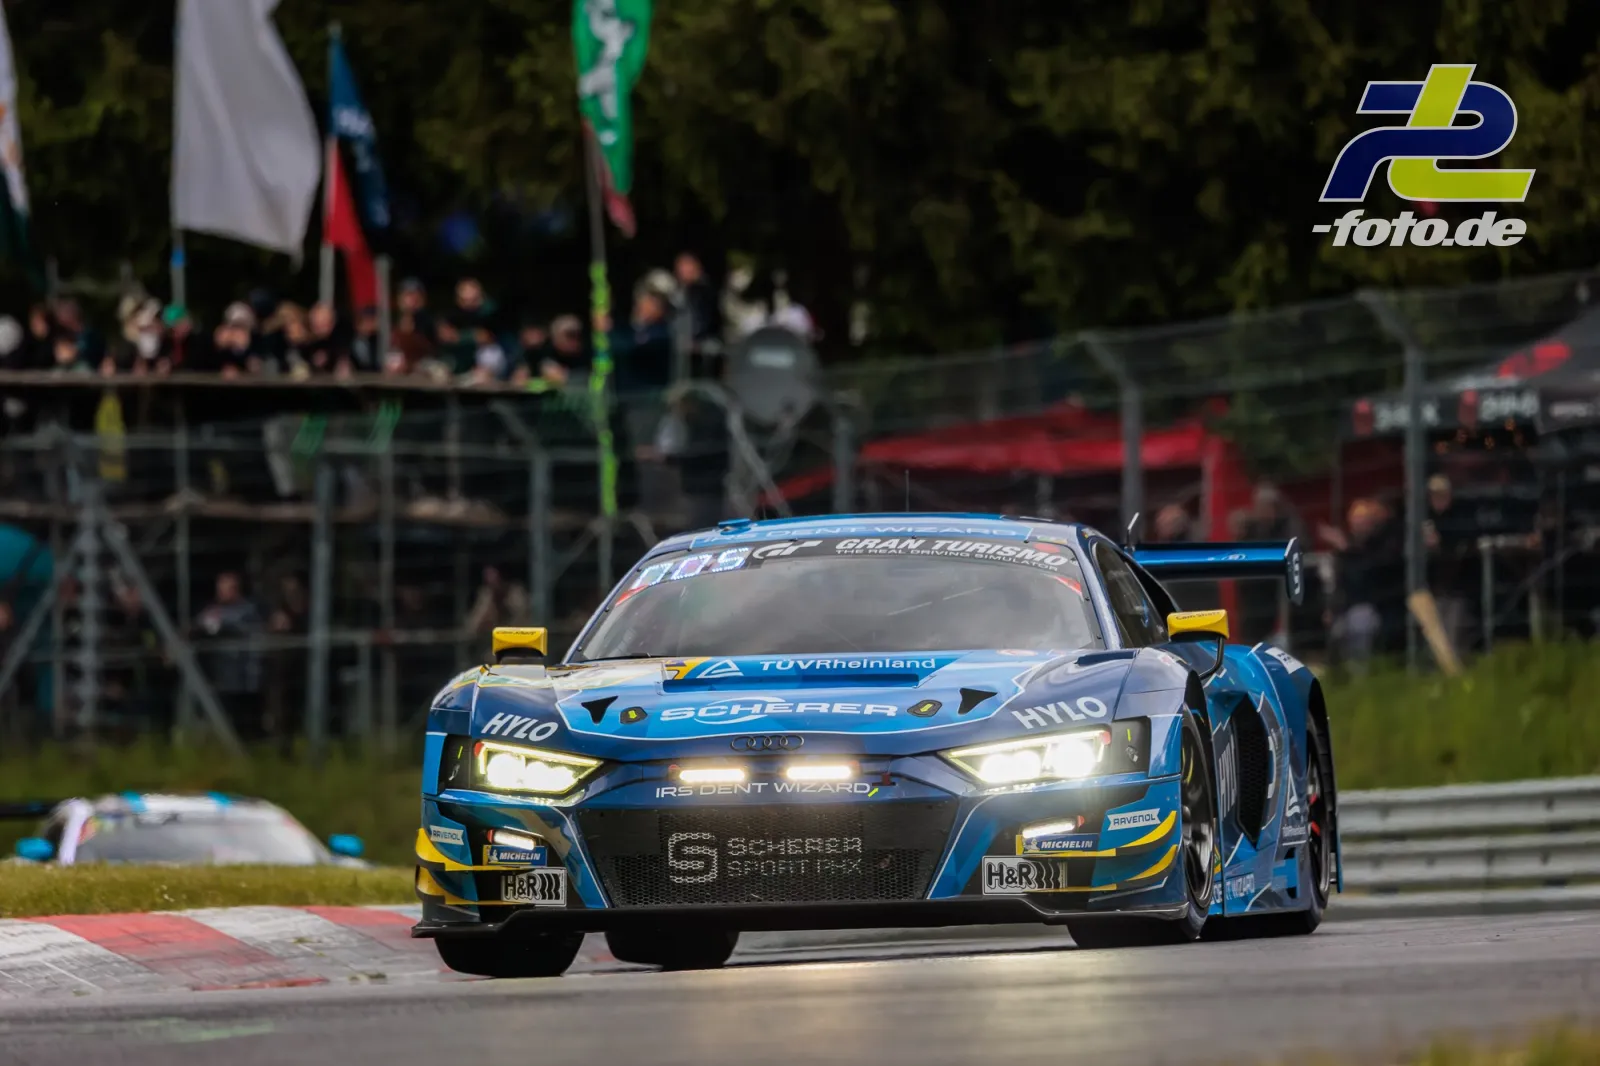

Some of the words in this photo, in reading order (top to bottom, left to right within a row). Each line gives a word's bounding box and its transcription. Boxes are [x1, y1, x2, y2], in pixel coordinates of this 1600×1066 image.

[875, 526, 1017, 536] WIZARD
[835, 538, 924, 550] GRAN
[932, 539, 1069, 566] TURISMO
[910, 549, 971, 558] DRIVING
[974, 553, 1058, 572] SIMULATOR
[760, 658, 936, 671] TÜVRheinland
[660, 700, 898, 723] SCHERER
[1010, 696, 1108, 730] HYLO
[481, 712, 559, 742] HYLO
[655, 786, 693, 798] IRS
[700, 782, 768, 796] DENT
[774, 781, 870, 794] WIZARD
[1113, 813, 1156, 826] RAVENOL
[432, 829, 461, 841] RAVENOL
[1041, 840, 1093, 849] MICHELIN
[727, 837, 862, 856] SCHERER
[499, 852, 541, 861] MICHELIN
[986, 862, 1035, 889] H&R
[504, 873, 540, 900] H&R
